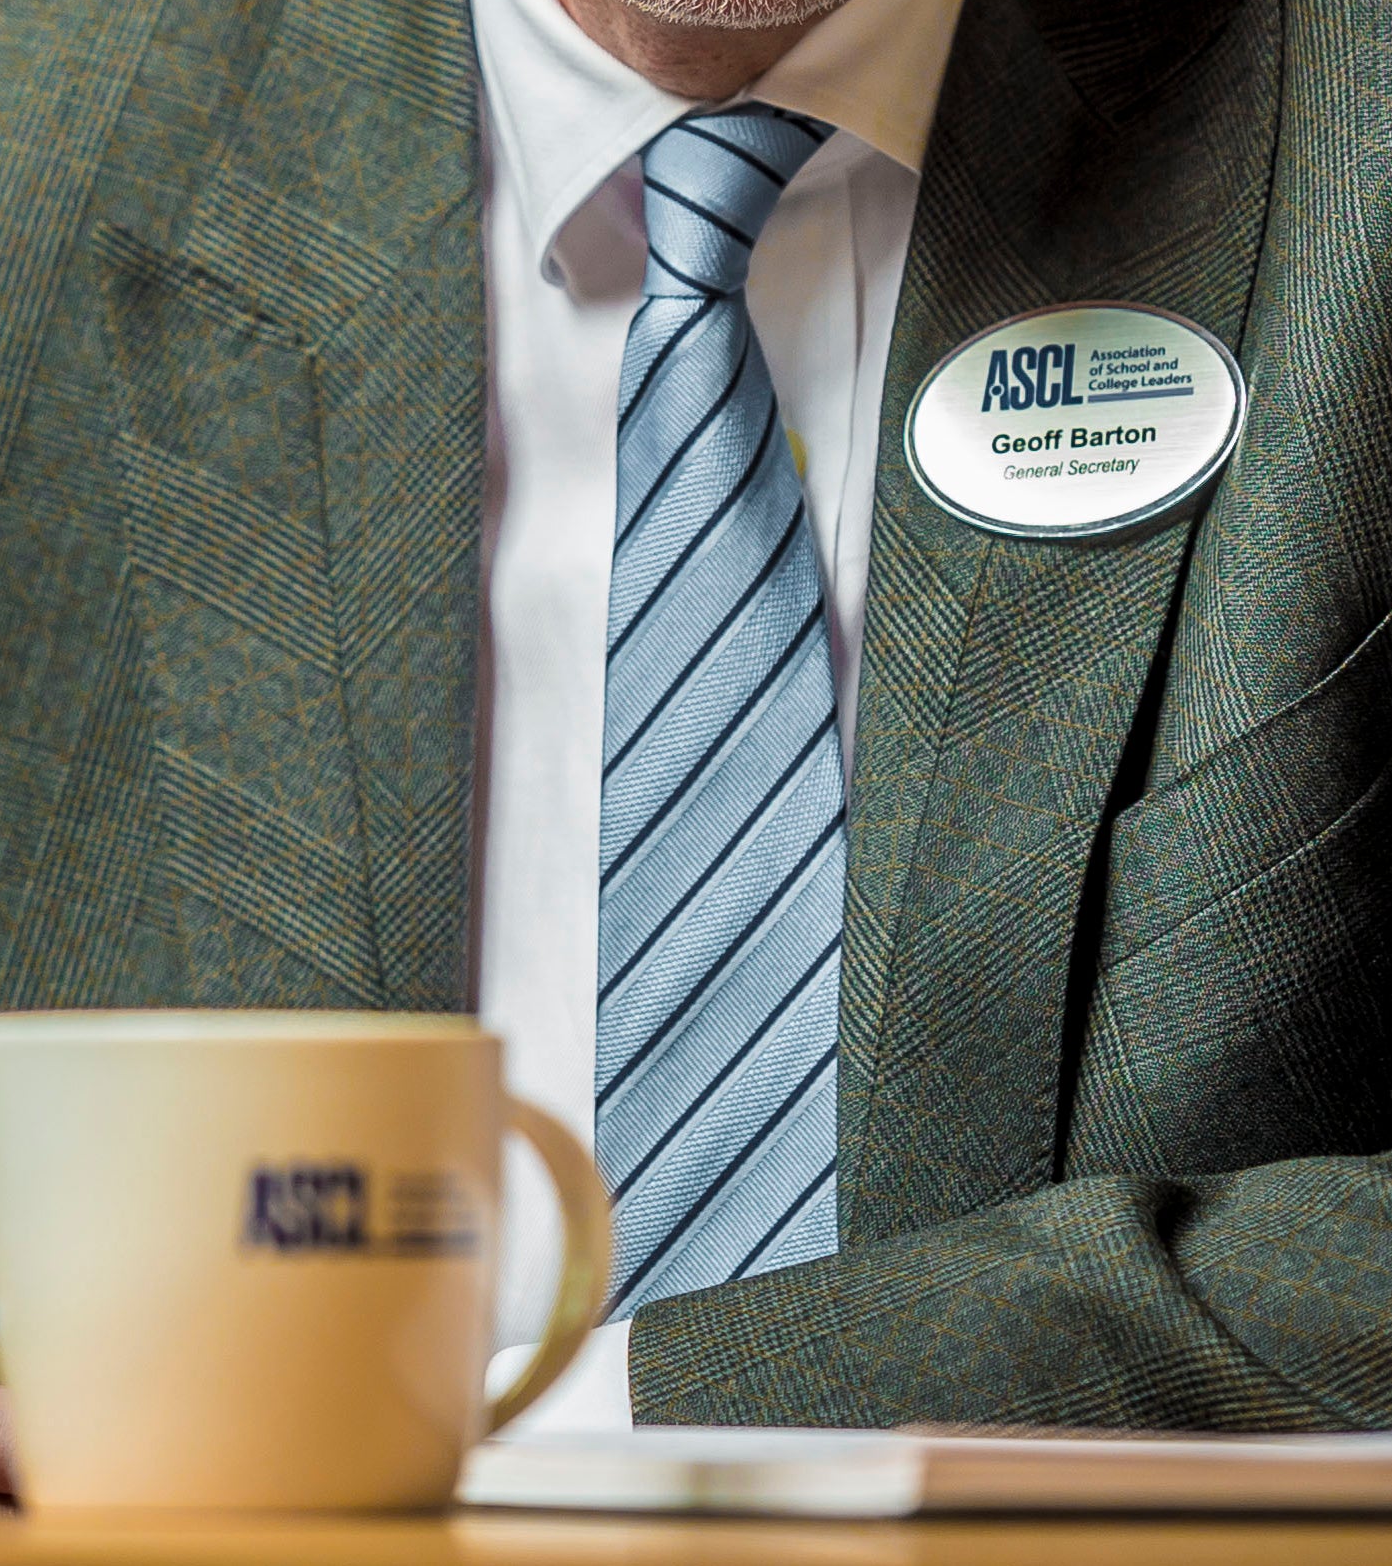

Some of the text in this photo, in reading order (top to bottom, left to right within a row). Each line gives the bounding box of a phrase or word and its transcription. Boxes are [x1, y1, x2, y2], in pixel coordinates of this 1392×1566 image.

[1090, 345, 1166, 362] Association
[1089, 357, 1179, 376] of School and
[981, 343, 1084, 413] ASCL
[1088, 373, 1193, 392] College Leaders
[991, 425, 1157, 454] Geoff Barton
[1003, 457, 1140, 481] General Secretary
